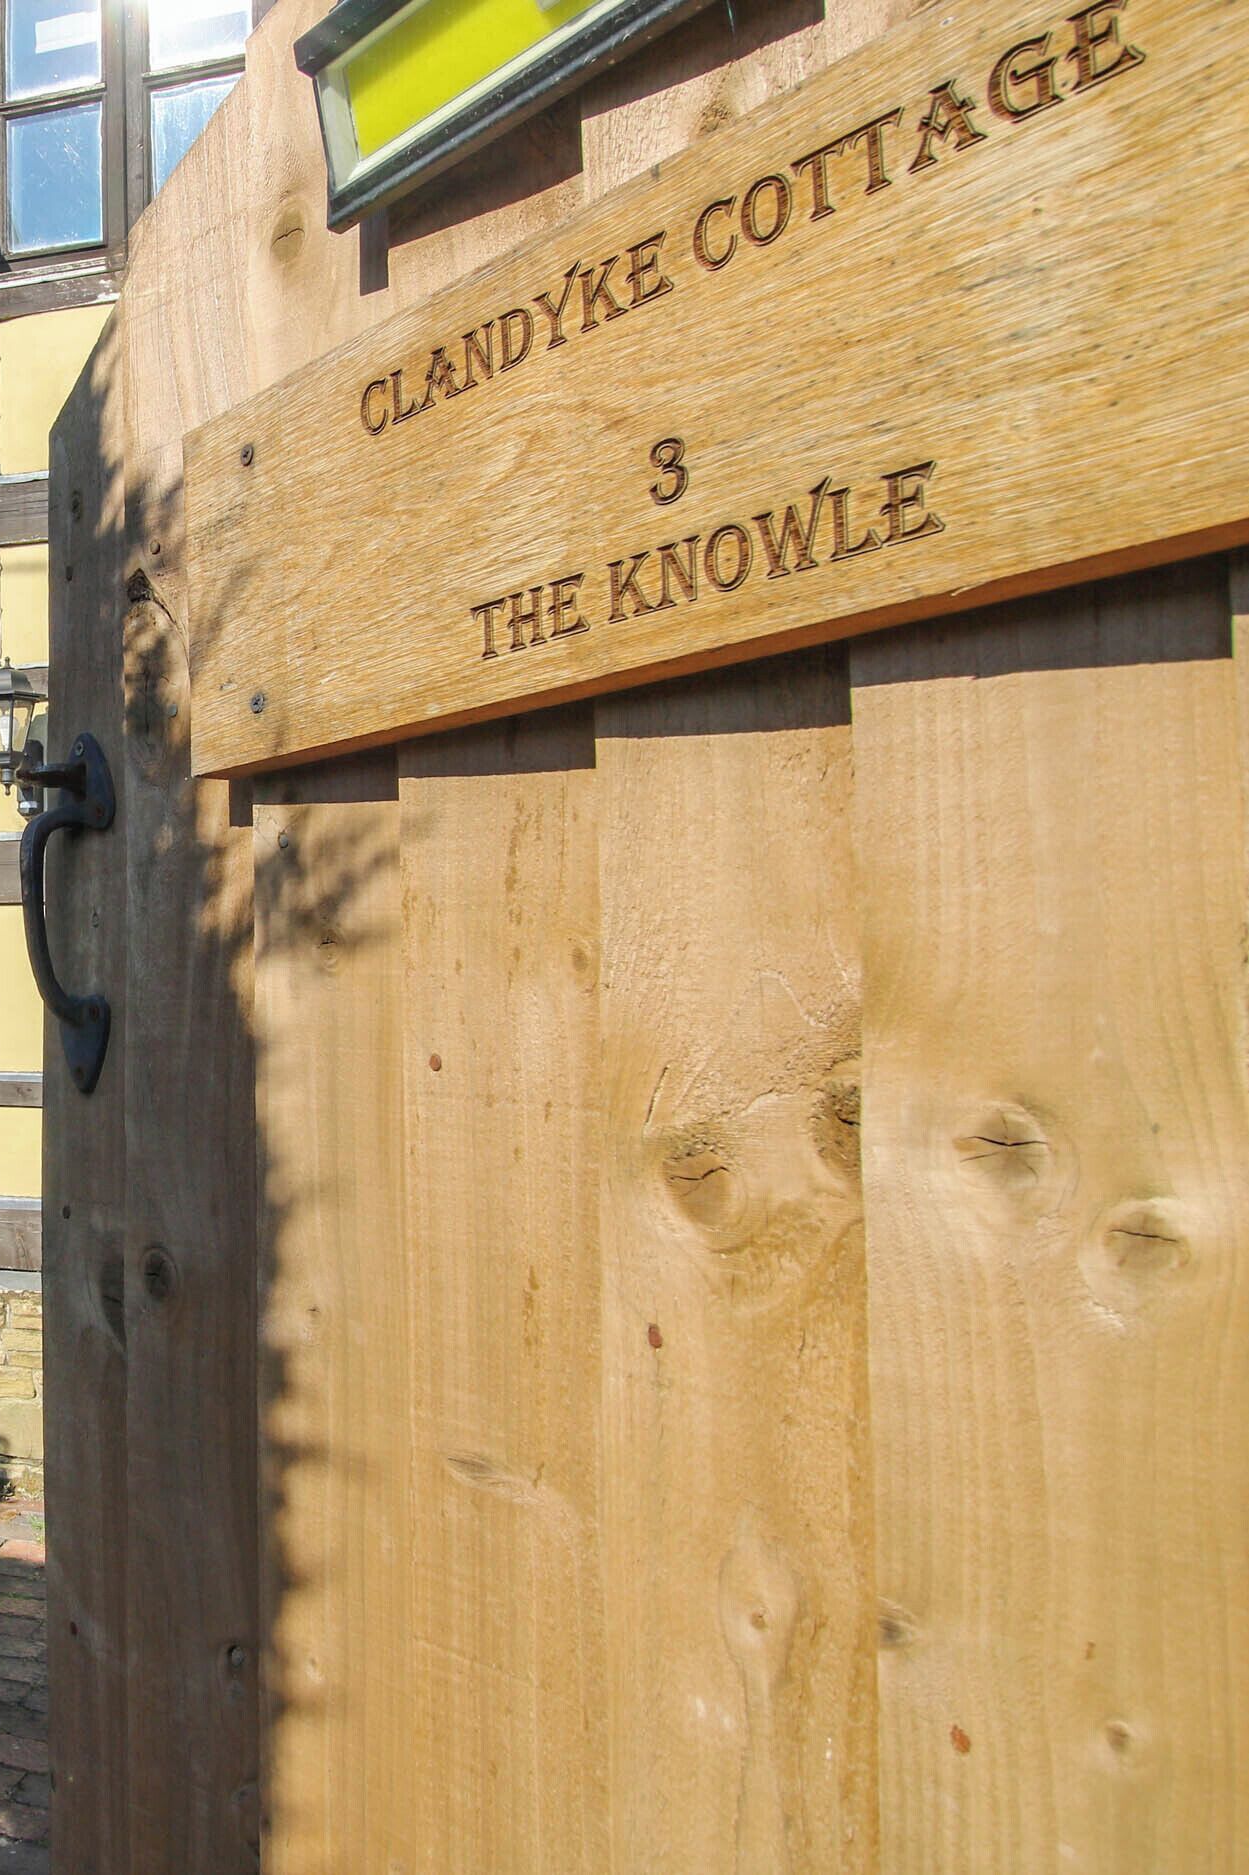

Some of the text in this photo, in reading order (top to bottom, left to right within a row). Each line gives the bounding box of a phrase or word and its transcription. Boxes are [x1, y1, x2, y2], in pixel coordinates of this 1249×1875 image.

[360, 0, 1146, 436] CLANDYKE COTTAGE
[471, 460, 945, 659] THE KNOWLE
[649, 437, 689, 505] 3
